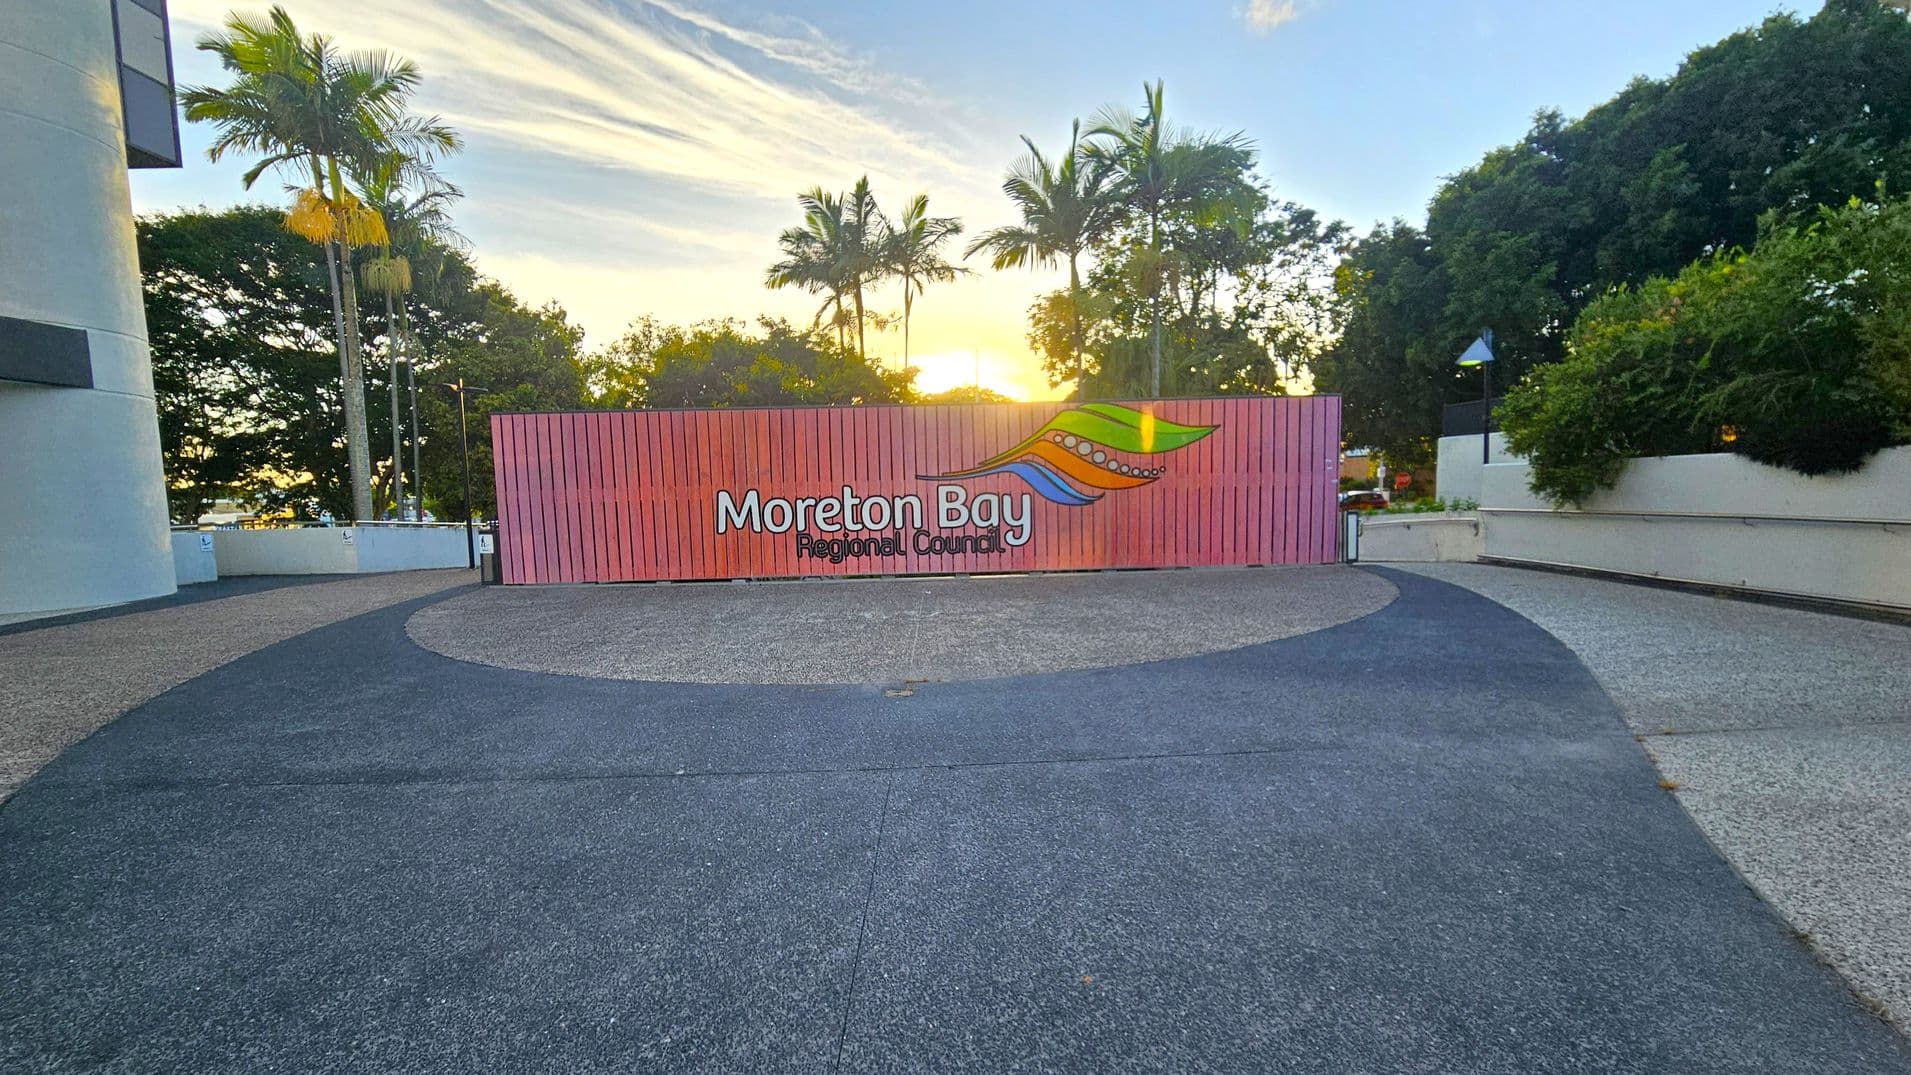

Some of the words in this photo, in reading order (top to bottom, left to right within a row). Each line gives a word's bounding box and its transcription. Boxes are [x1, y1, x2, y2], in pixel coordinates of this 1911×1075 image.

[717, 485, 923, 534] Moreton
[936, 484, 1033, 546] Bay
[797, 532, 905, 563] Regional
[912, 529, 1006, 556] Council
